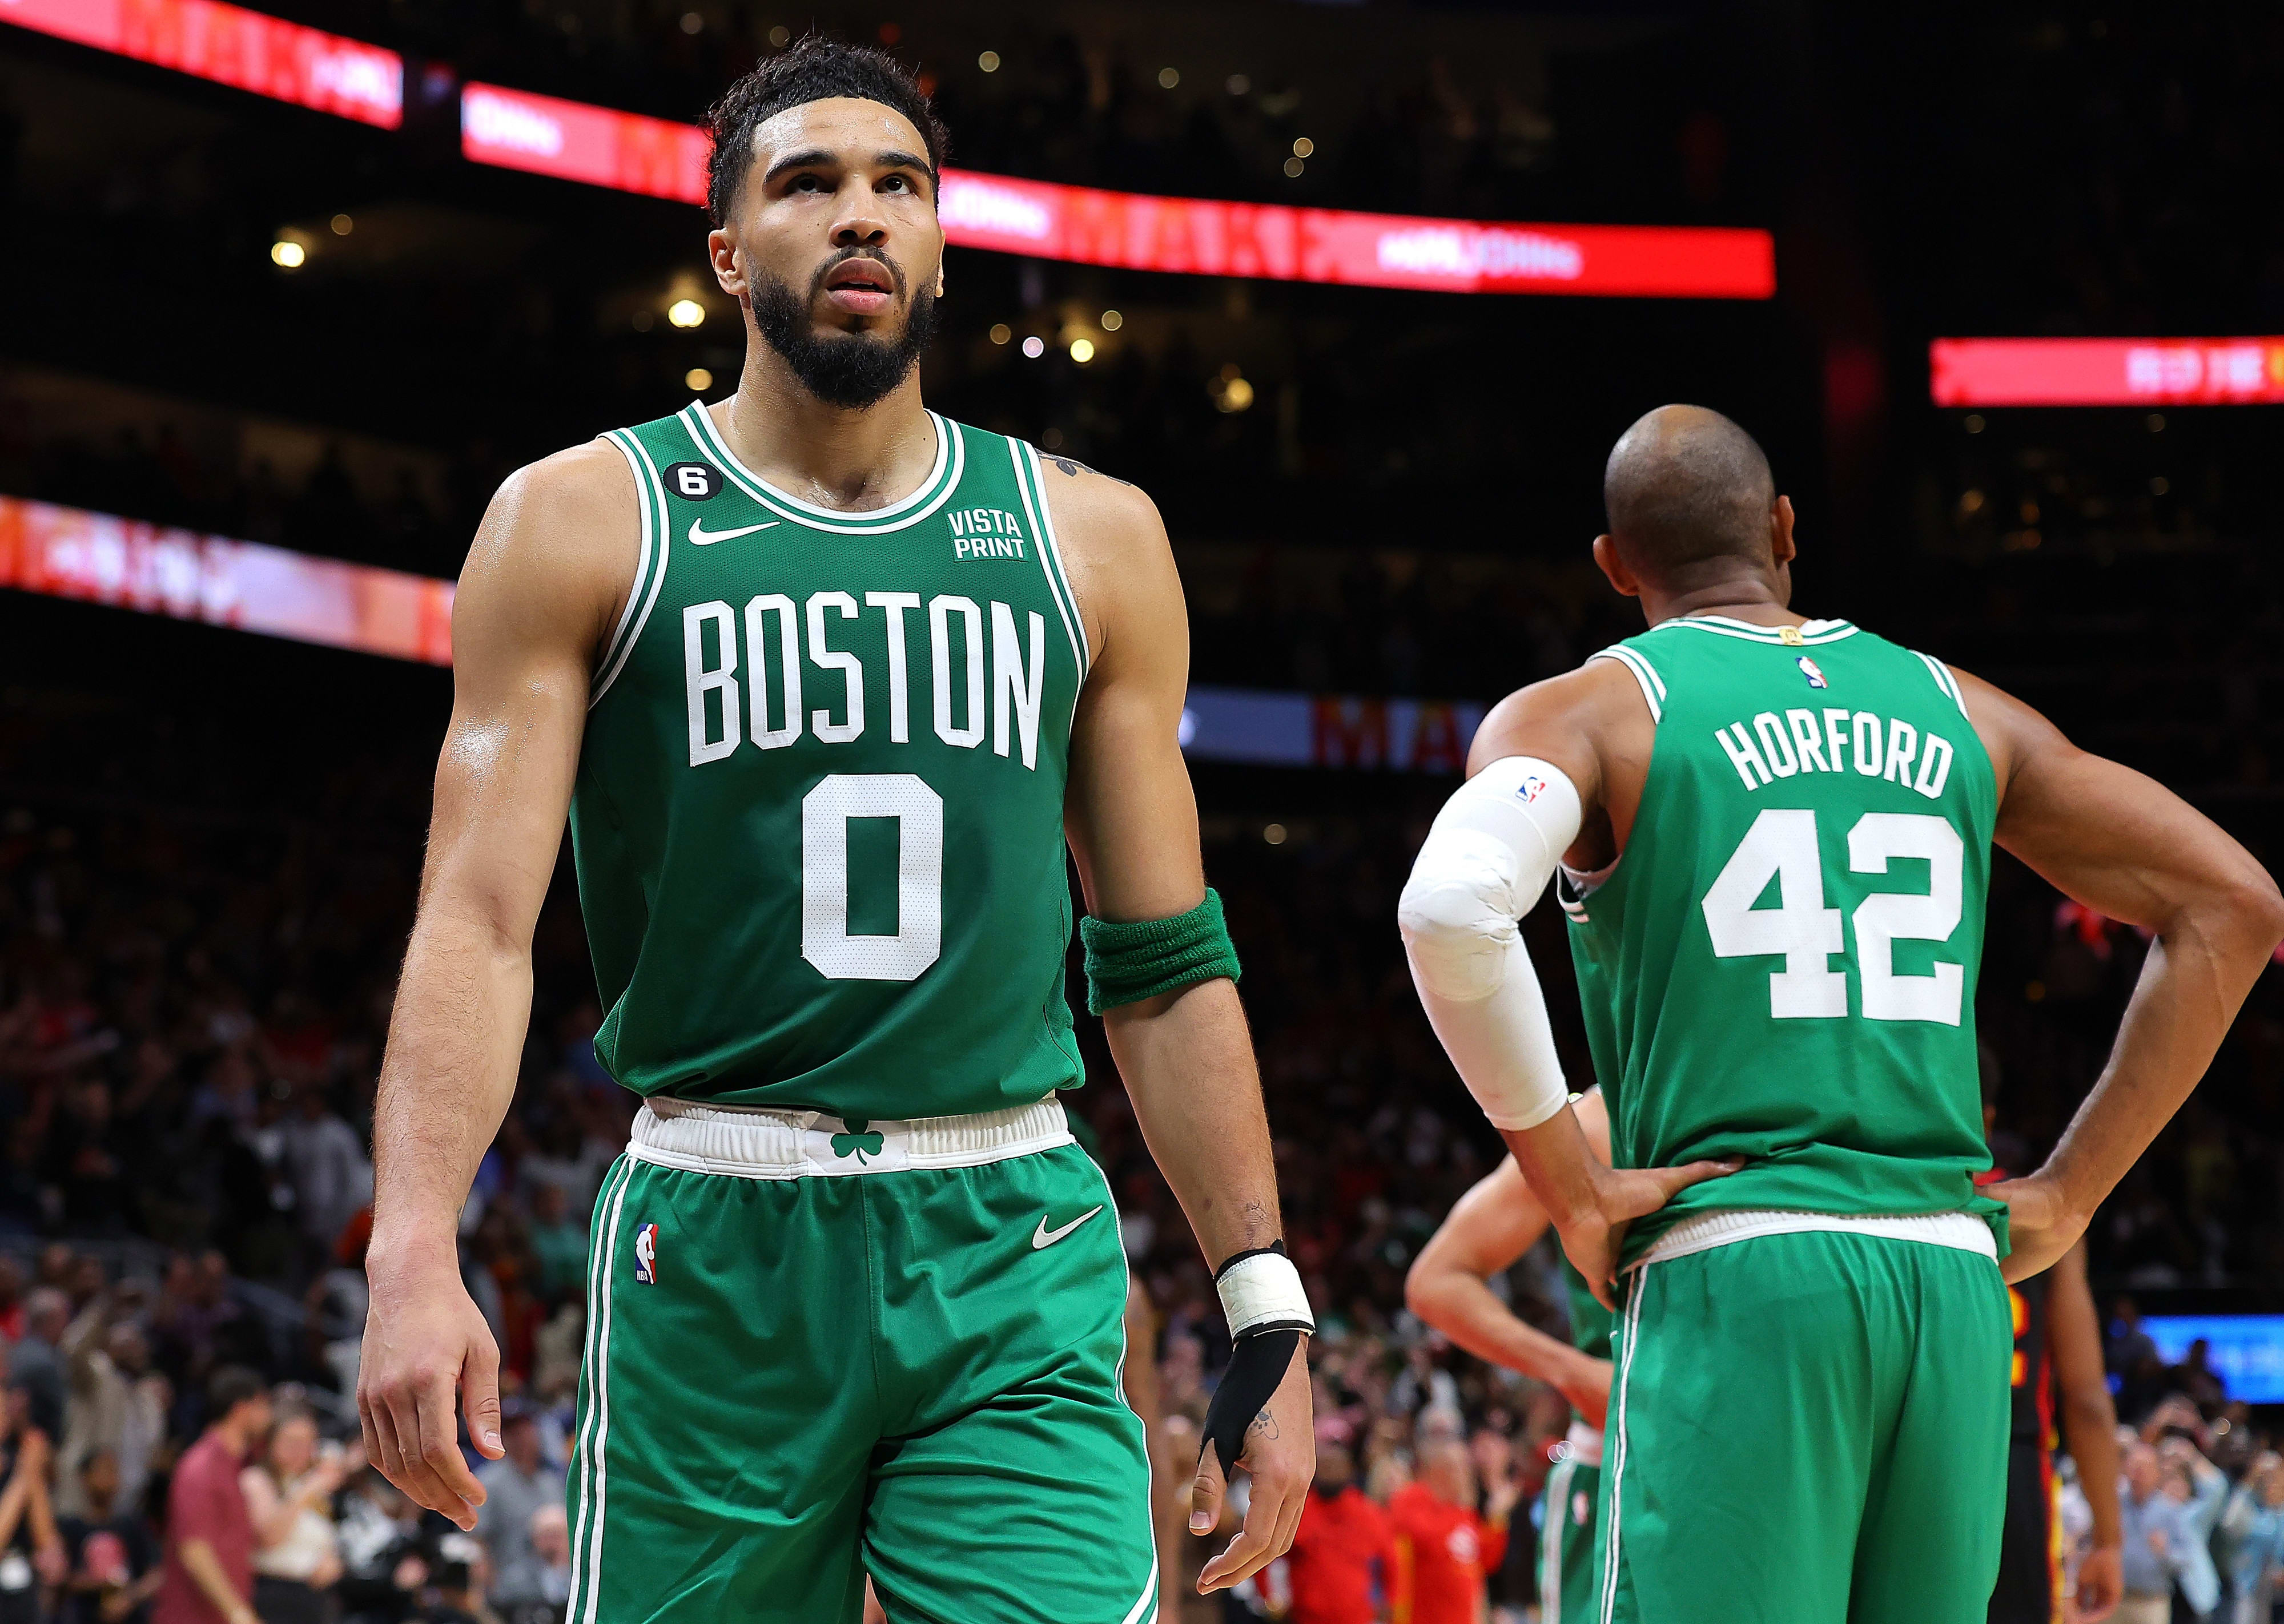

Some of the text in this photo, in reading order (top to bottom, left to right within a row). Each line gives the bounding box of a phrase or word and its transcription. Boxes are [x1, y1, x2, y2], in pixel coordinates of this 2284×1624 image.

[677, 466, 709, 495] 6
[947, 508, 1023, 538] VISTA
[954, 537, 1024, 559] PRINT
[682, 591, 1046, 772] BOSTON
[1714, 708, 1954, 799] HORFORD
[802, 773, 943, 981] 0
[1700, 808, 1964, 1027] 42
[637, 1270, 649, 1282] NBA
